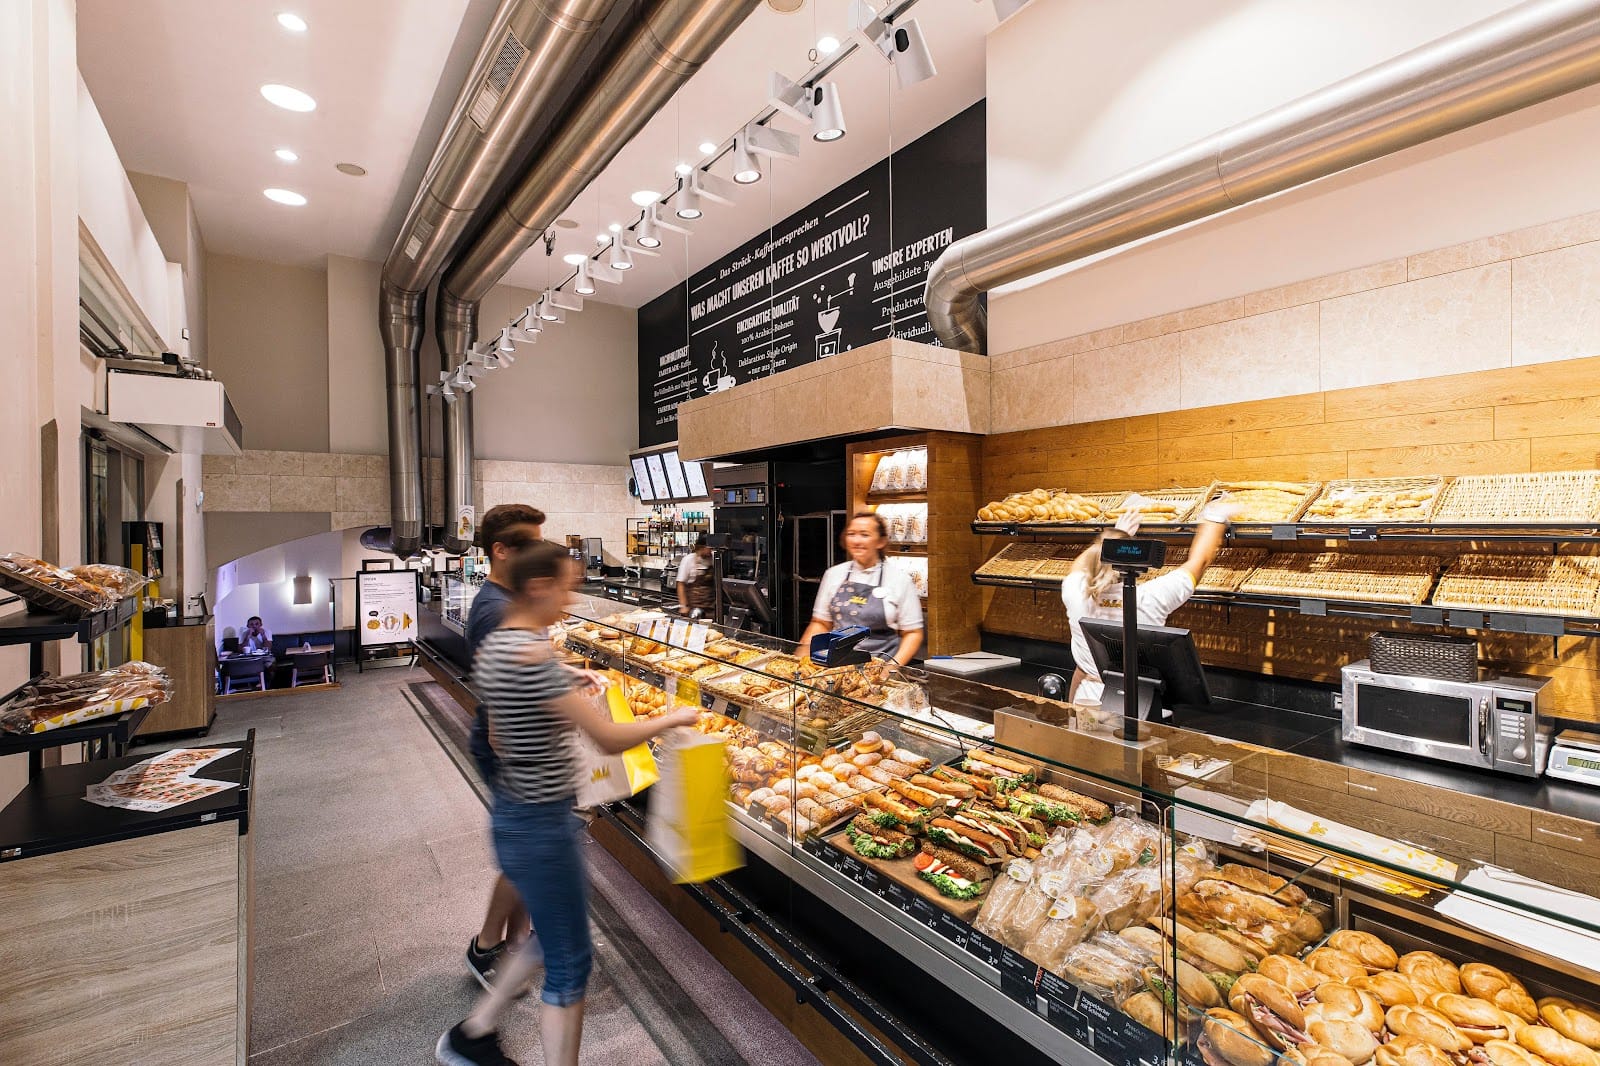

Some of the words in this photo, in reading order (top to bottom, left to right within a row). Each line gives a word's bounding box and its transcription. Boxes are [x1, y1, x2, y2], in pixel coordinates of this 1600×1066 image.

[905, 226, 953, 262] EXPERTEN
[690, 301, 706, 322] WAS
[706, 286, 731, 315] MACHT
[732, 270, 765, 301] UNSEREN
[765, 253, 795, 284] KAFFEE
[796, 246, 810, 269] SO
[810, 213, 870, 262] WERTVOLL?
[719, 268, 731, 280] Das
[873, 265, 922, 292] Ausgebildete
[736, 308, 771, 334] EINZIGARTIGE
[771, 295, 800, 320] QUALITÄT
[881, 293, 925, 317] Produktwi
[738, 352, 766, 368] Deklaration
[780, 342, 798, 353] Origin
